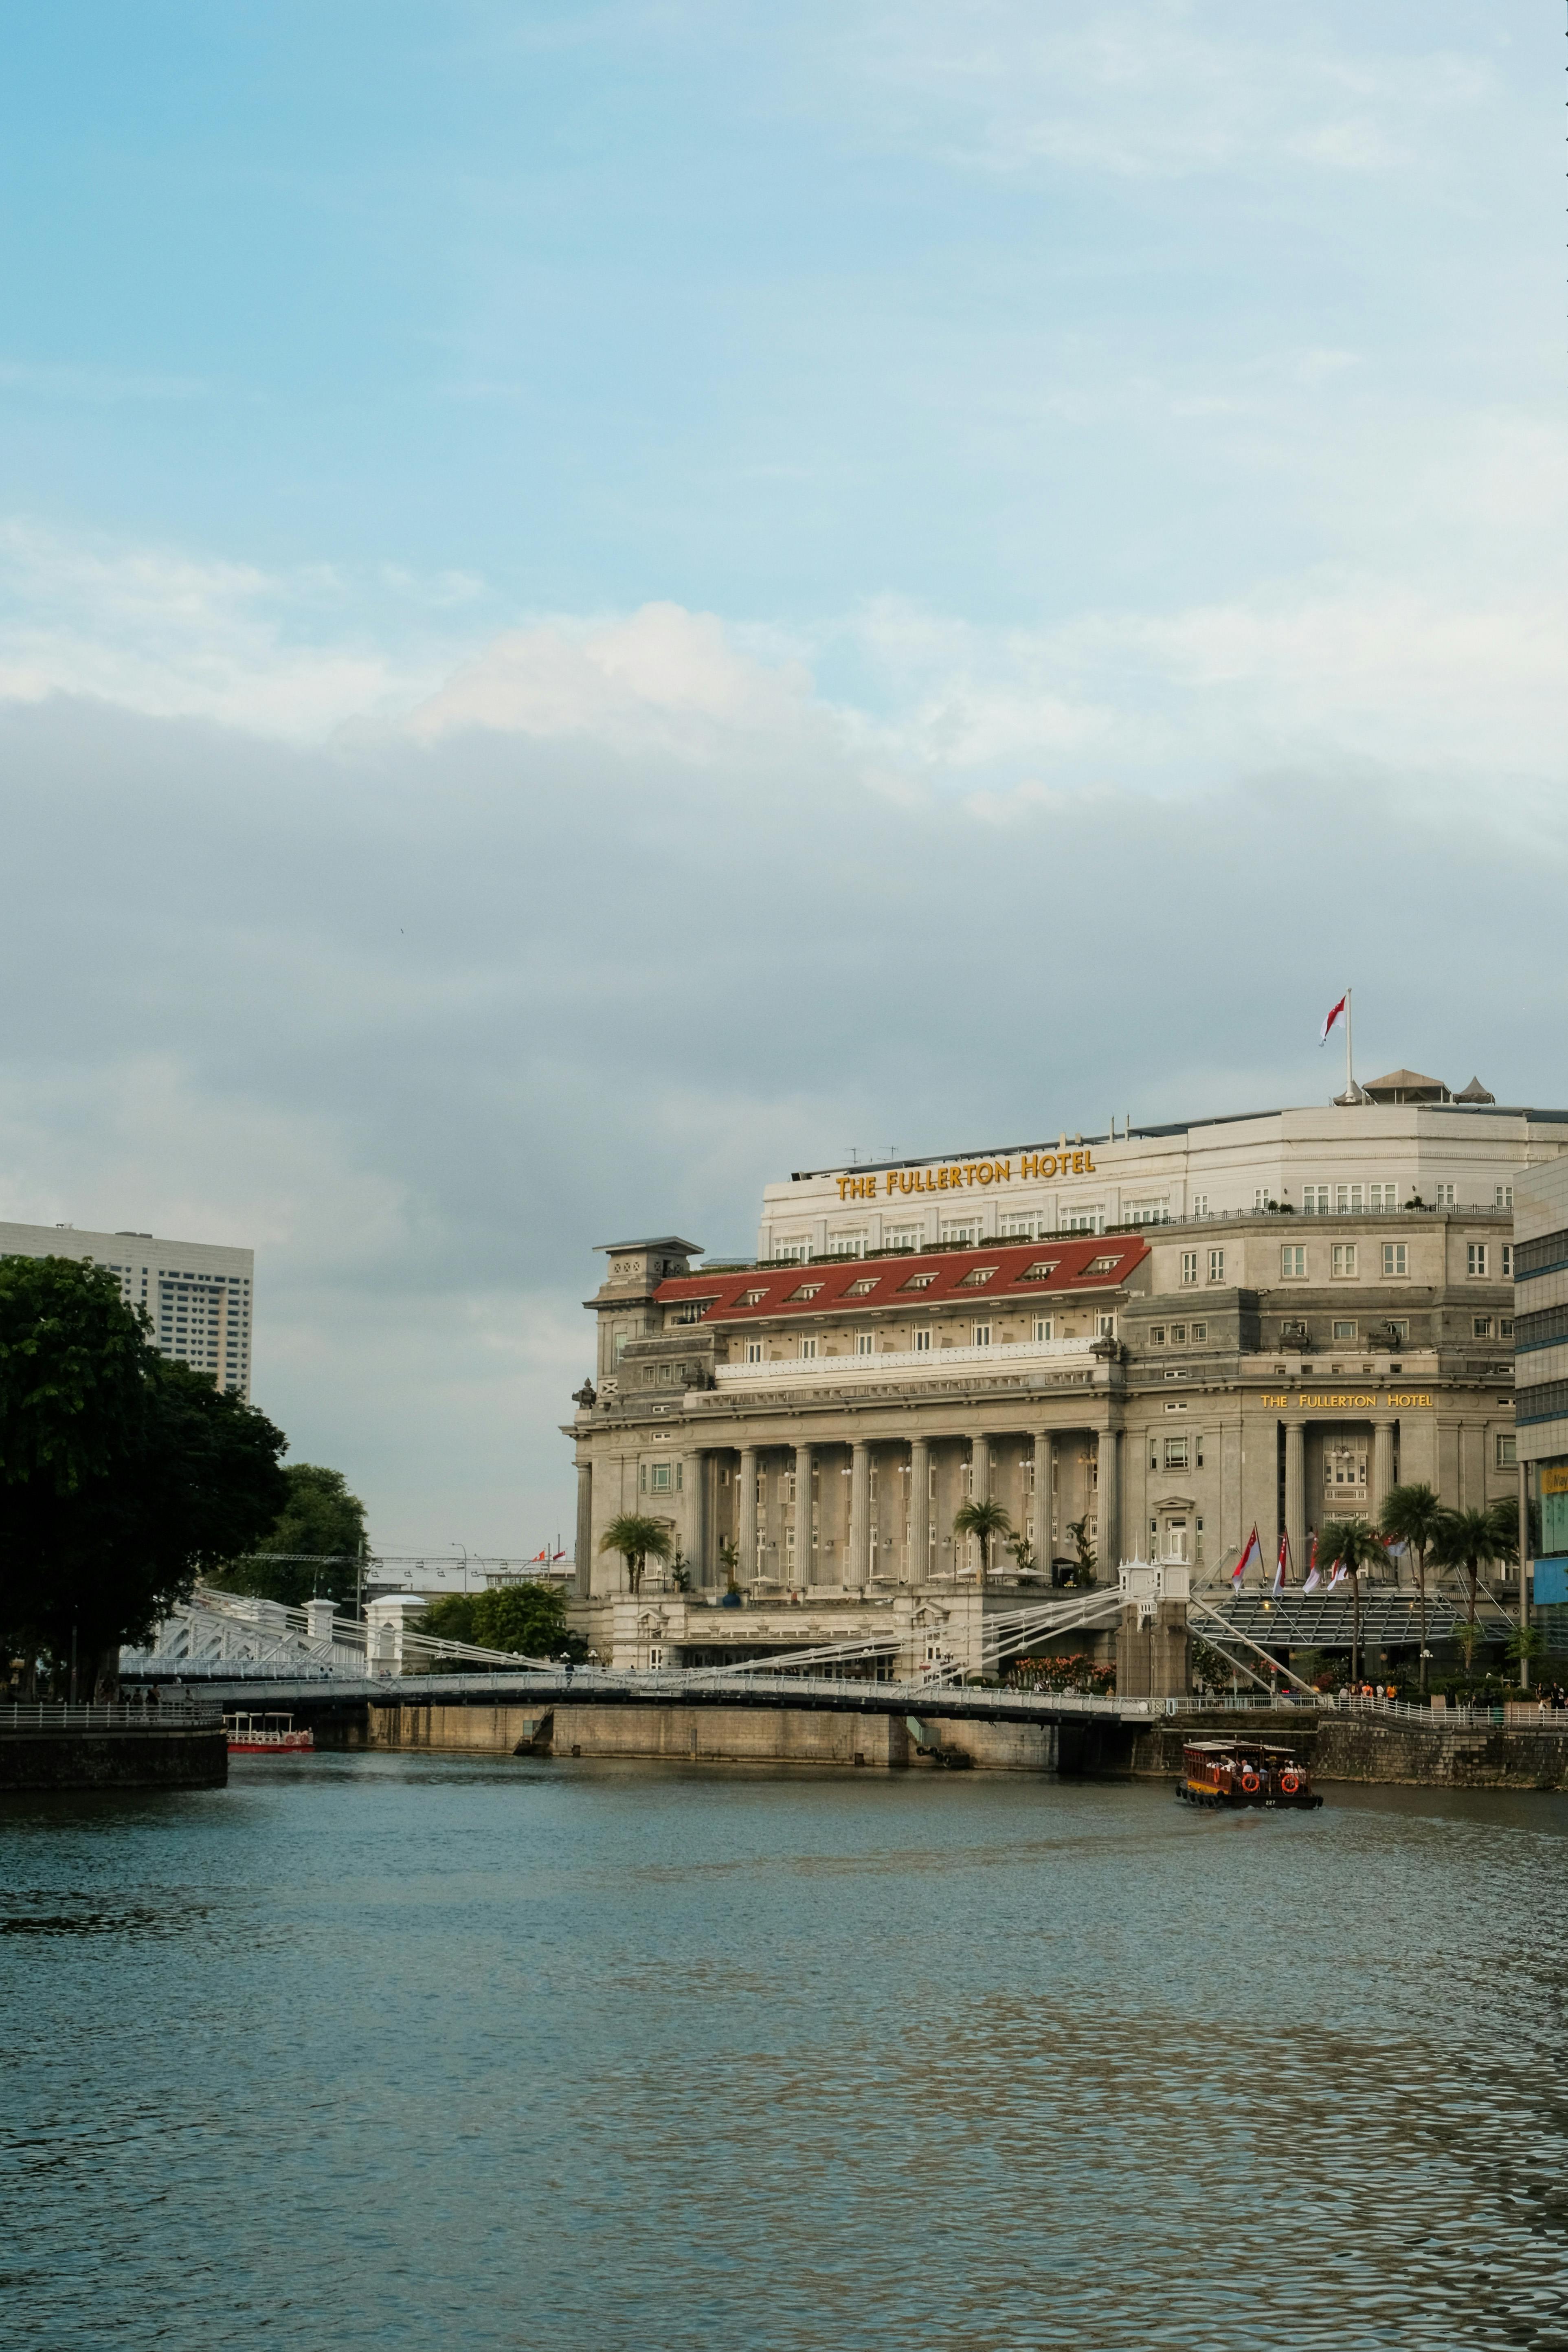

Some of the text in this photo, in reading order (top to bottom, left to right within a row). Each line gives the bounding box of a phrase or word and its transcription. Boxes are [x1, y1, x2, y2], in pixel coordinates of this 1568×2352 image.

[836, 1150, 1095, 1200] THE FULLERTON HOTEL
[1261, 1395, 1433, 1408] THE FULLERTON HOTEL
